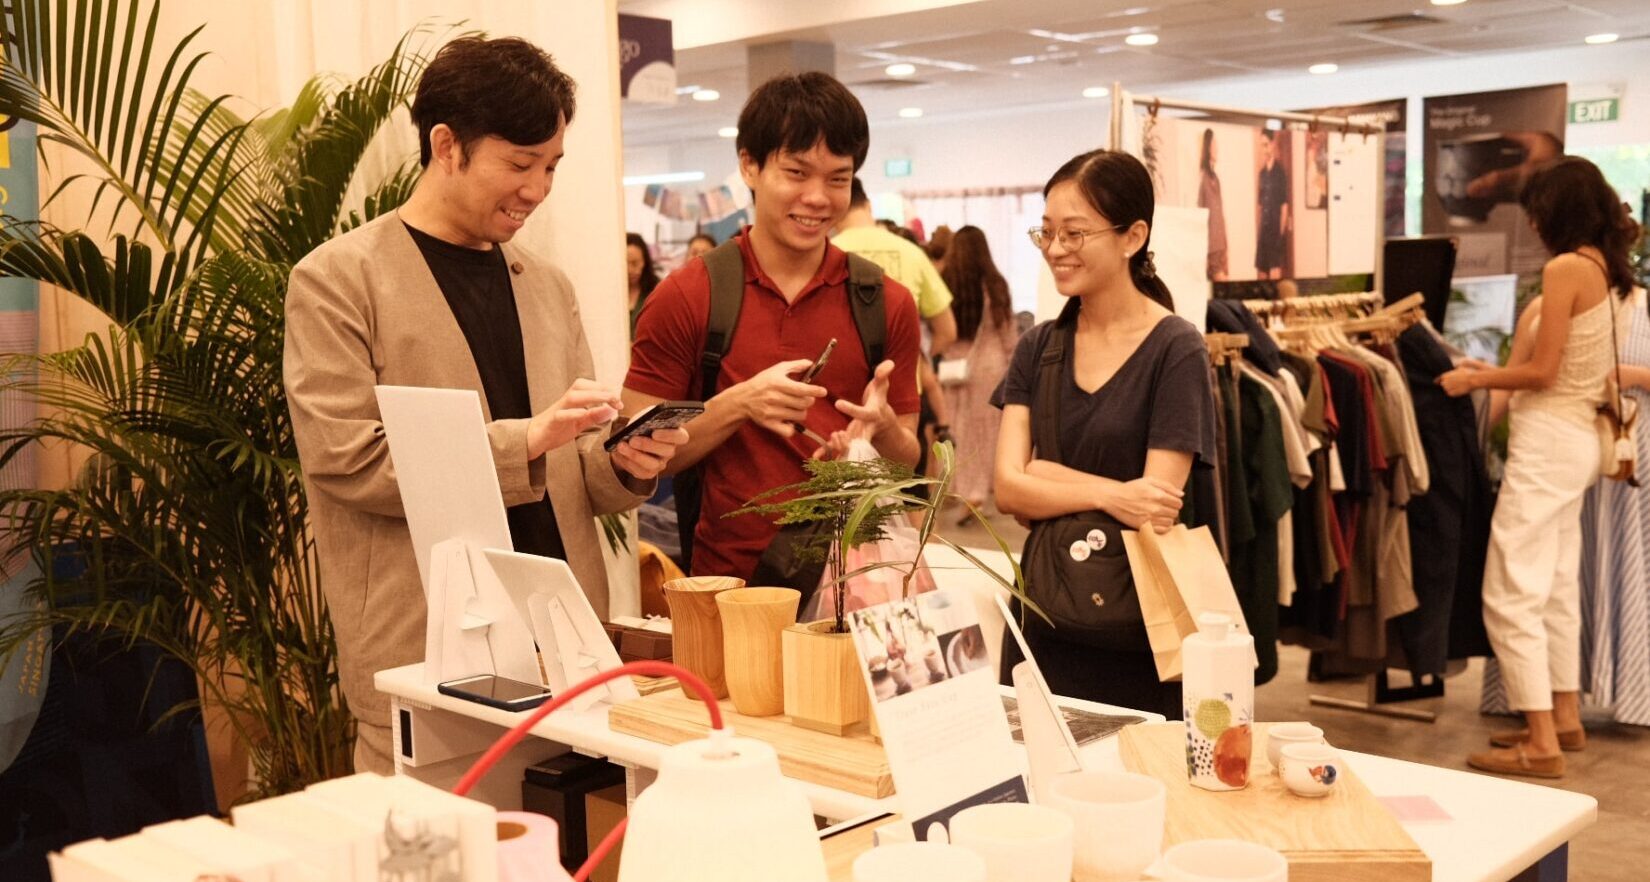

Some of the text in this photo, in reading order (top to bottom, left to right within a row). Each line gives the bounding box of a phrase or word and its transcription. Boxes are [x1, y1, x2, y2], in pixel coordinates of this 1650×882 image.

[1575, 101, 1611, 122] EXIT
[1430, 114, 1492, 130] Magic Cup
